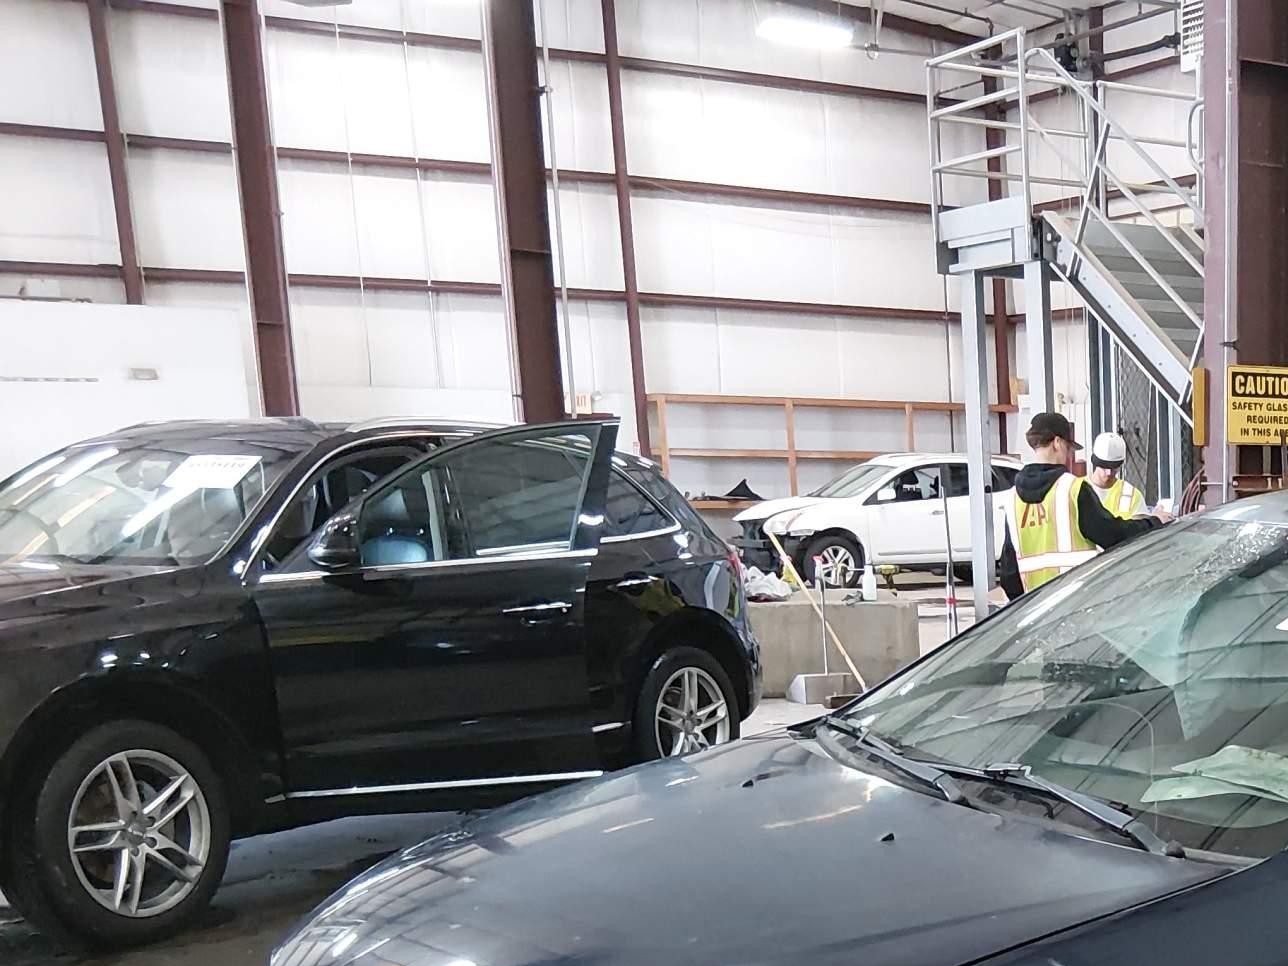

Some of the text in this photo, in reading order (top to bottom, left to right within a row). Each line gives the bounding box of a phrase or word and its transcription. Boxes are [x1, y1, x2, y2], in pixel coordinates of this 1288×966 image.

[1232, 402, 1264, 411] SAFETY
[1240, 427, 1249, 437] IN
[1251, 427, 1272, 437] THIS
